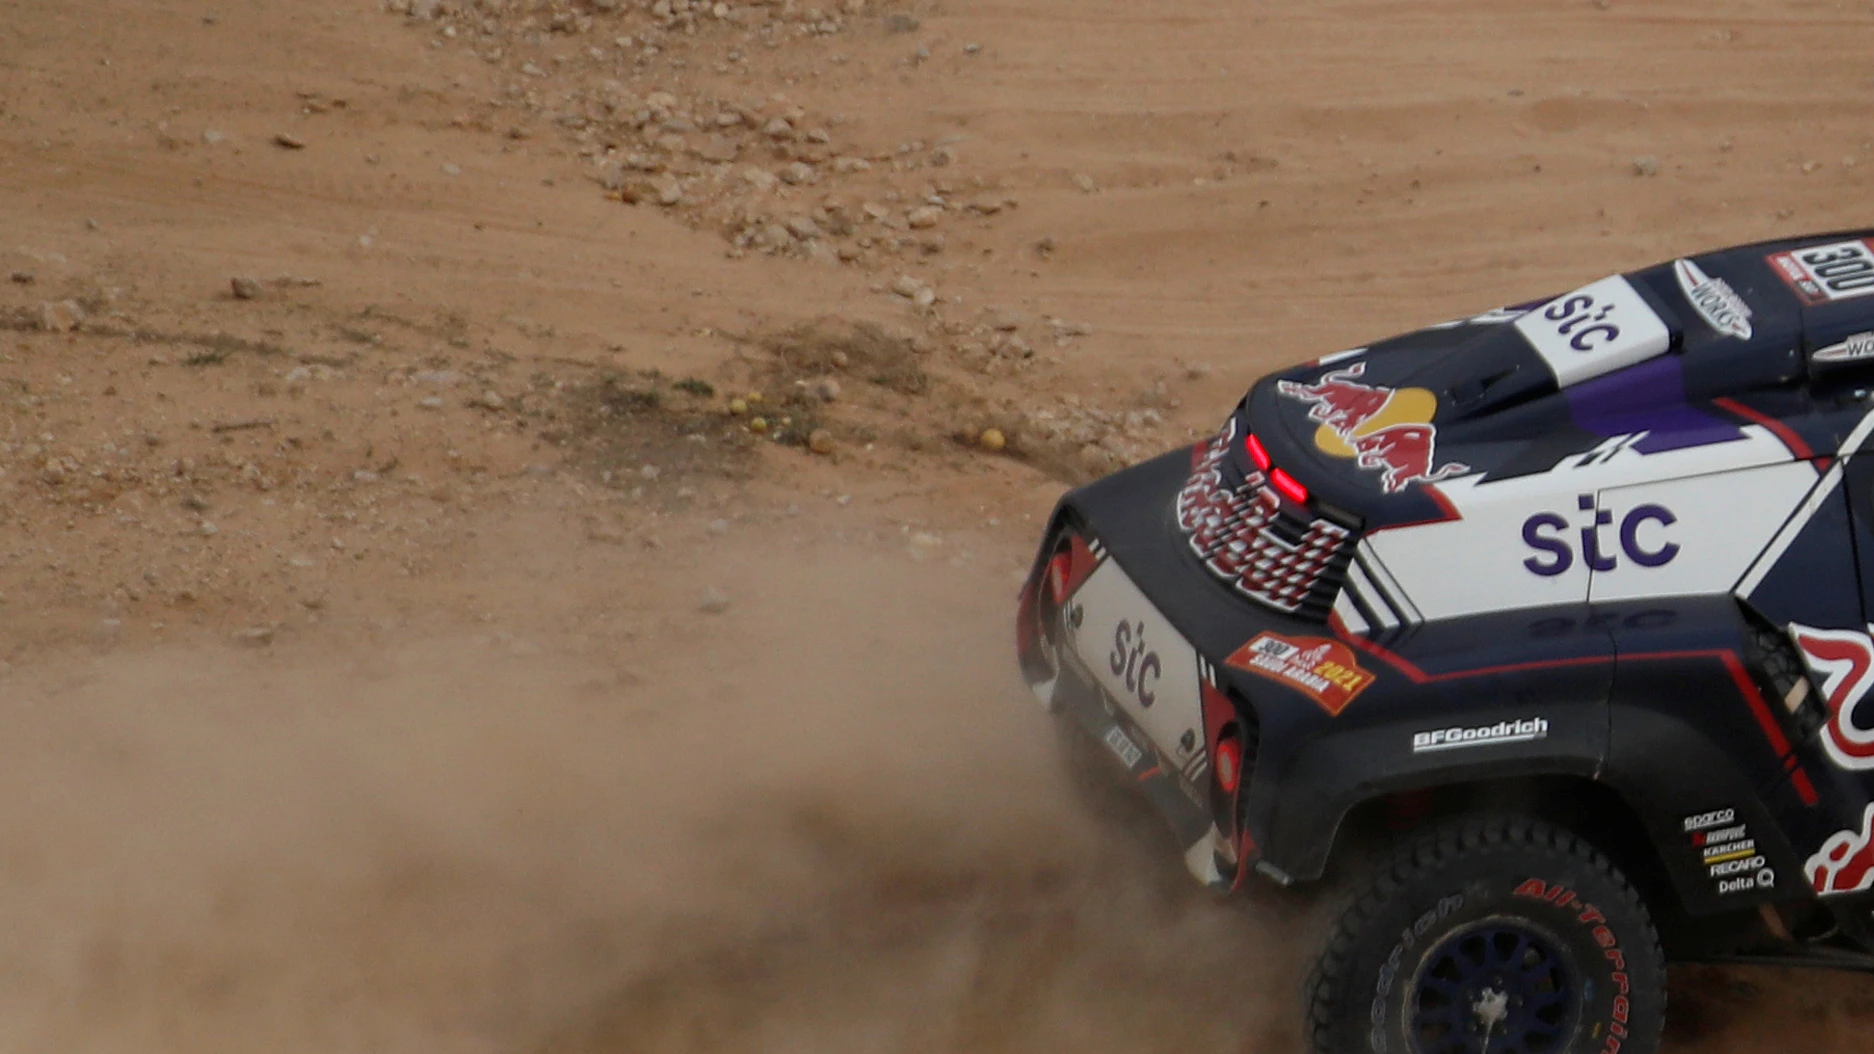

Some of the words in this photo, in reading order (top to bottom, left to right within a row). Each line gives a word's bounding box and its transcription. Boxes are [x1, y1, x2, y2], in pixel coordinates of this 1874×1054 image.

[1522, 494, 1680, 576] stc
[1314, 661, 1362, 691] 2021
[1413, 717, 1548, 748] BFGoodrich
